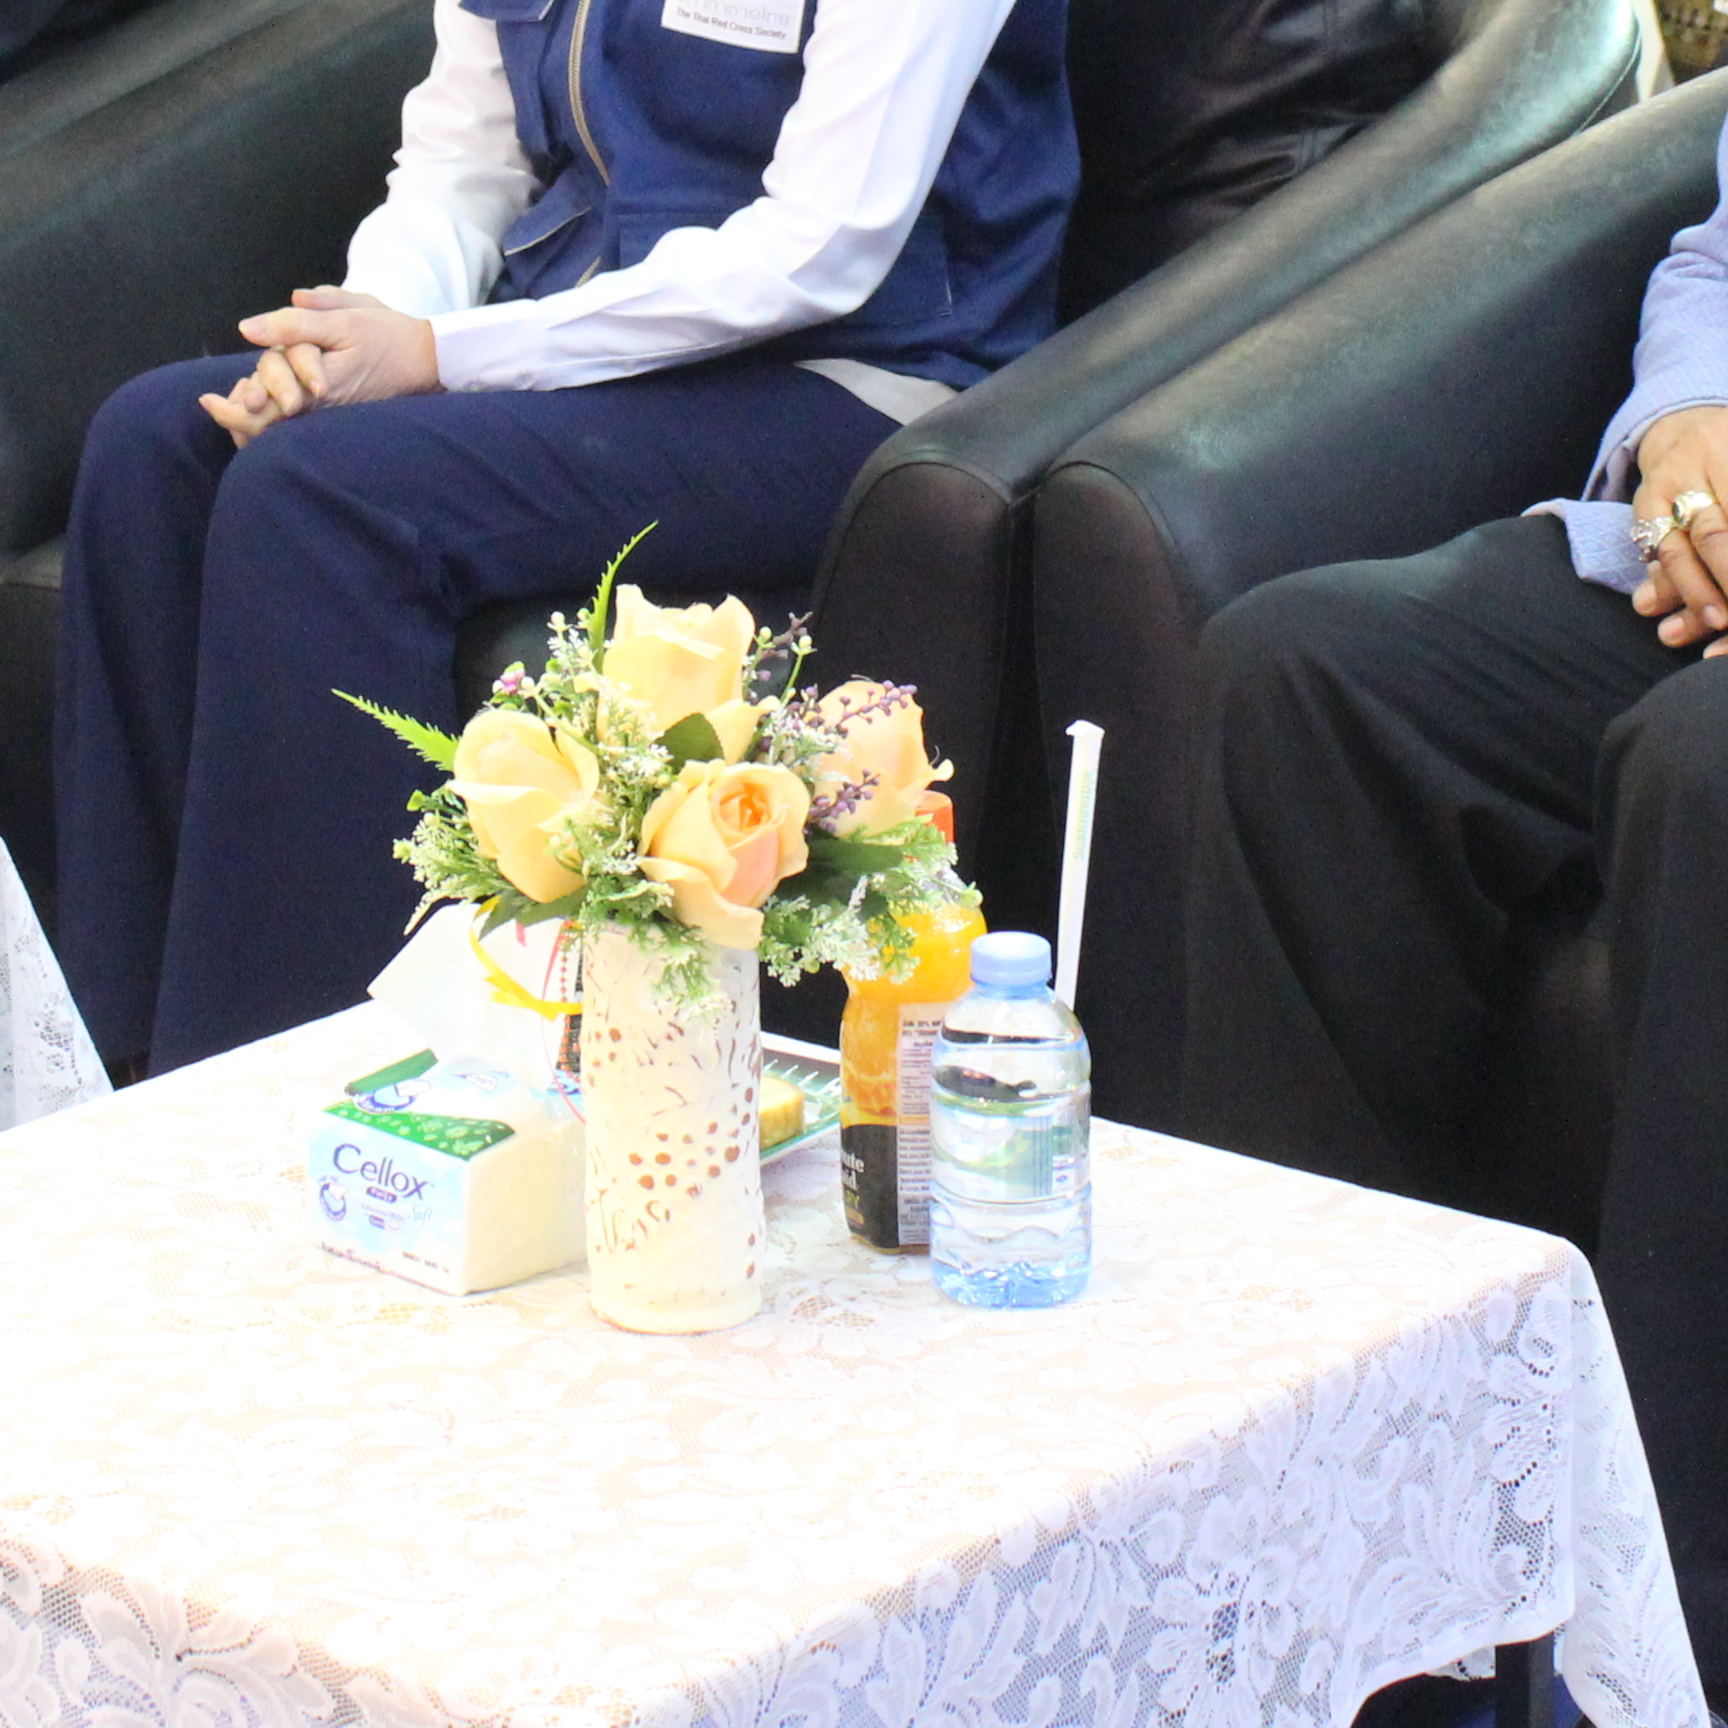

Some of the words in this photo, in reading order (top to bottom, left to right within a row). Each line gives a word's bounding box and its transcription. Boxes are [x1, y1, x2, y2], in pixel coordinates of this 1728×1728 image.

[676, 7, 691, 19] The
[693, 12, 710, 25] Thai
[711, 16, 728, 29] Red
[729, 20, 753, 35] Cross
[755, 26, 788, 41] Society
[333, 1143, 428, 1201] Cellox
